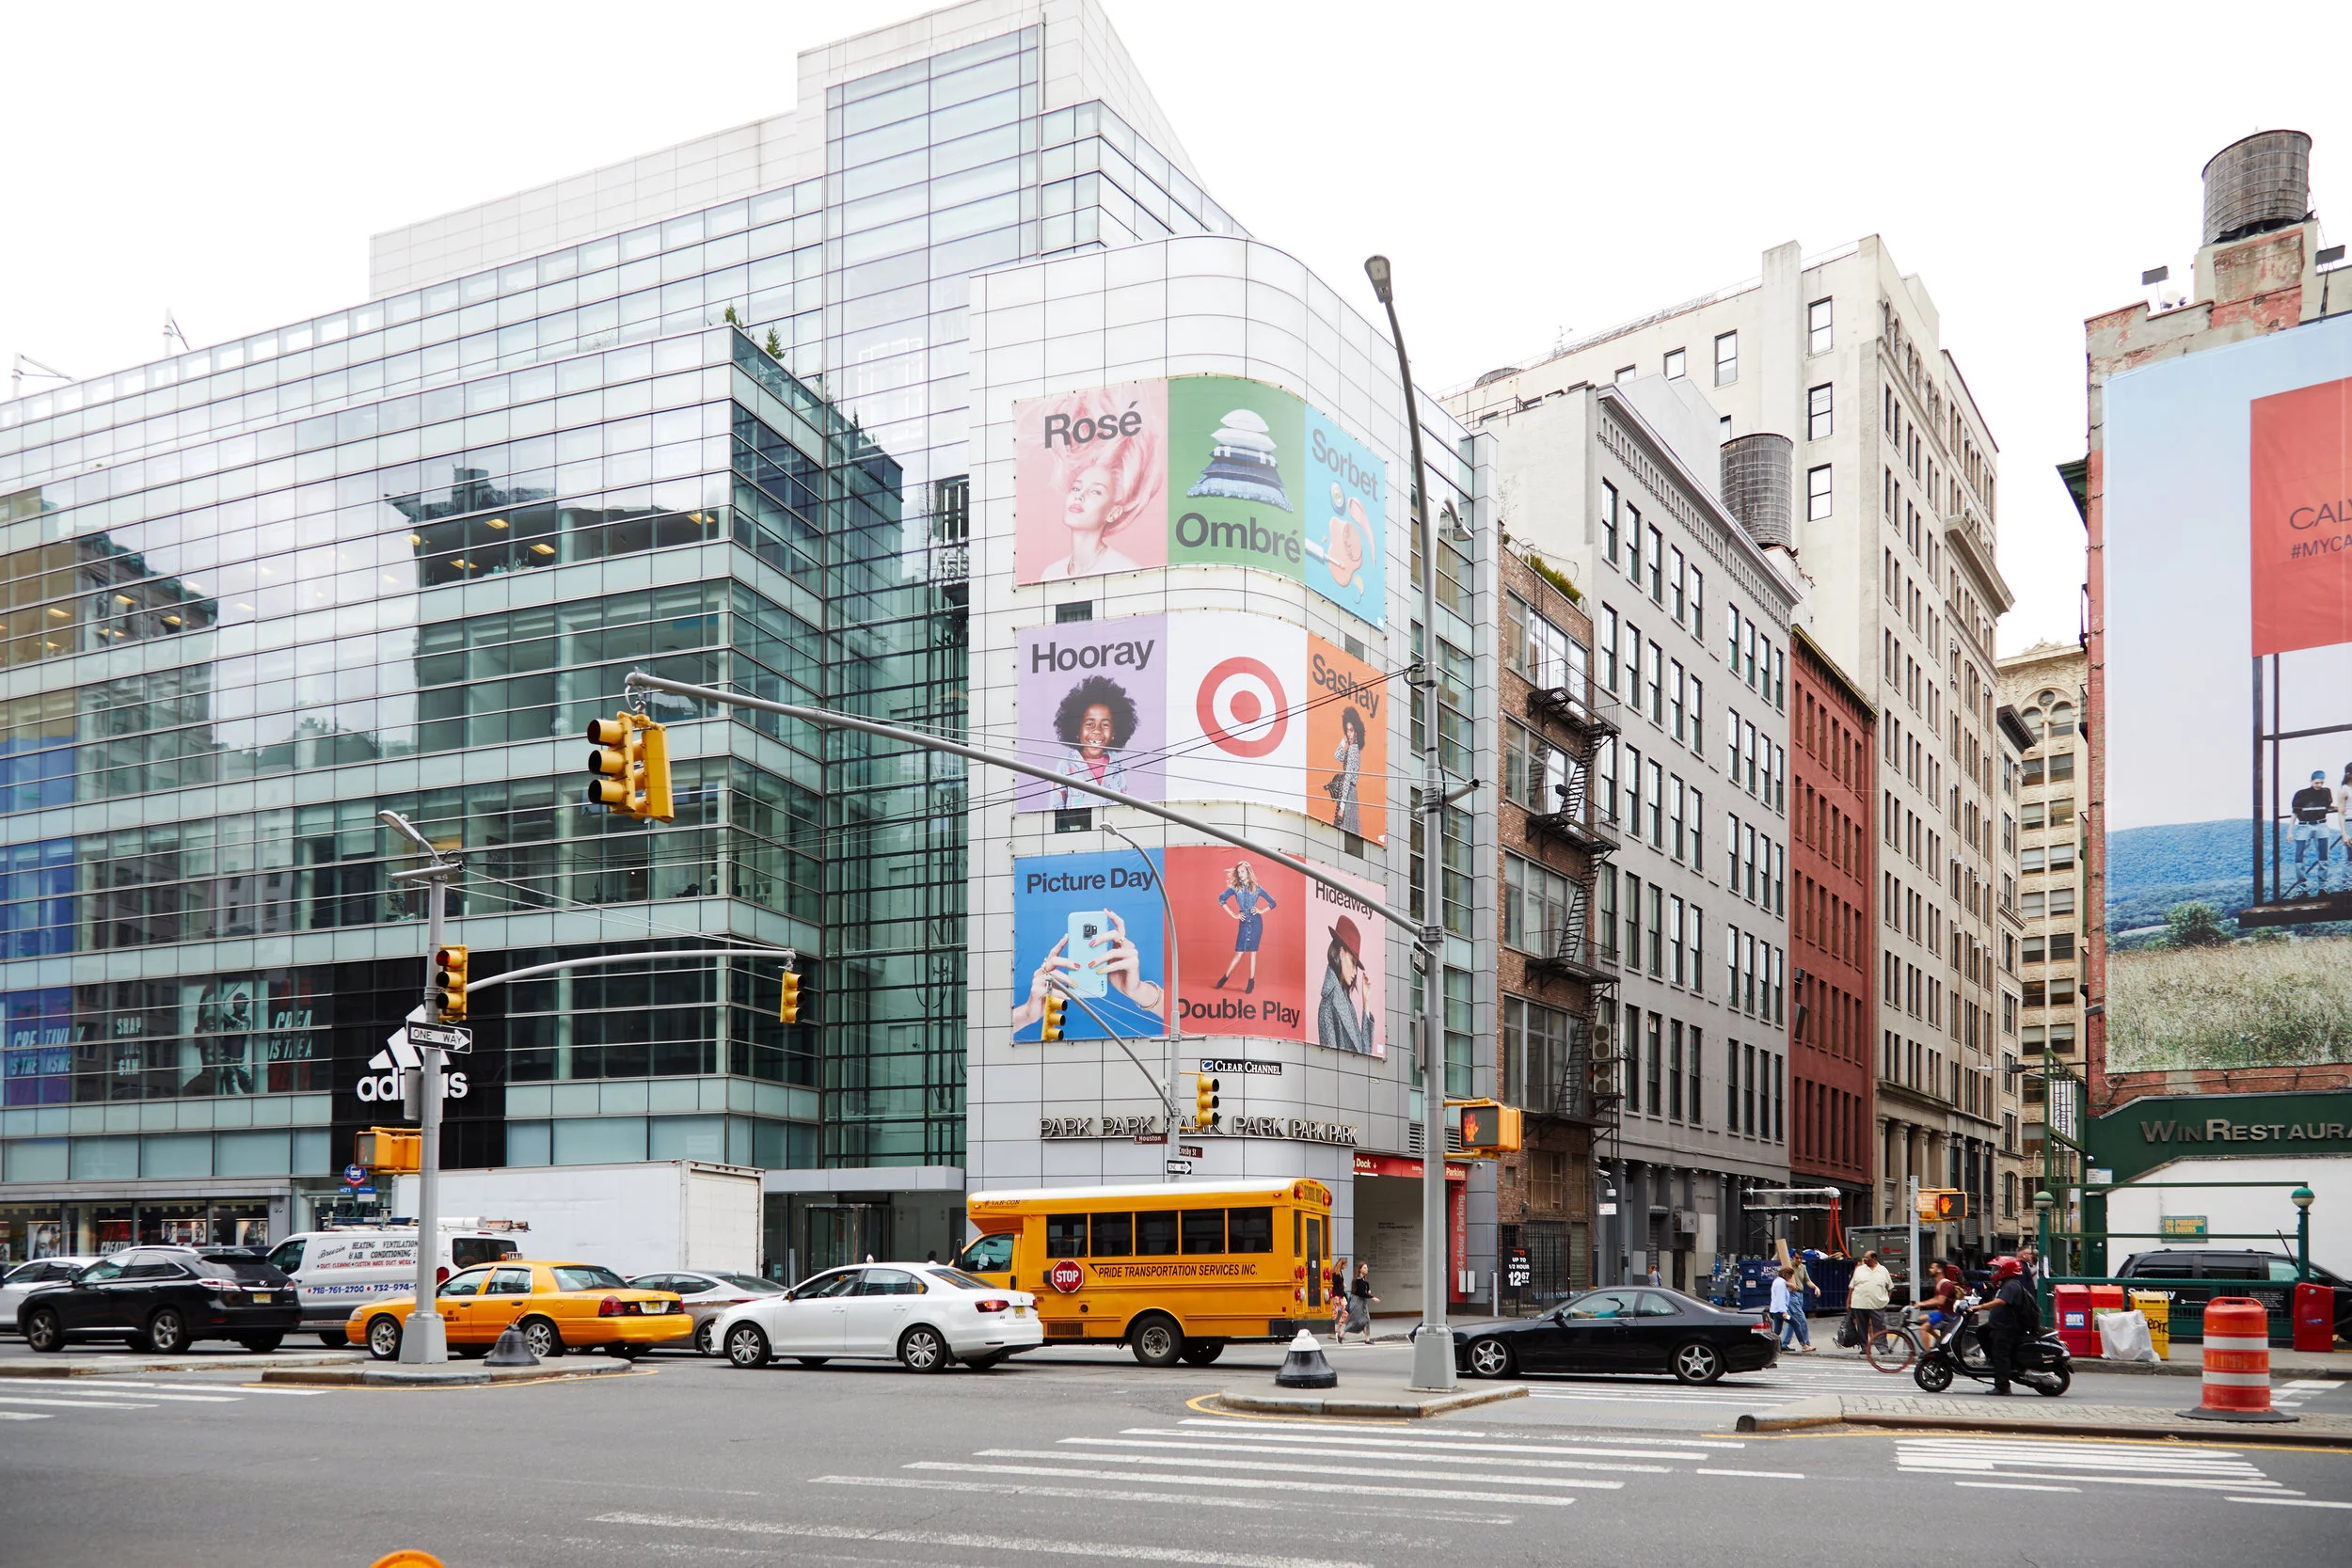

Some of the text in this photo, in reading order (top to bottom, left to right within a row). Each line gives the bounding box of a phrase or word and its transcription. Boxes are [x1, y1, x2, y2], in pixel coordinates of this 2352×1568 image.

[1044, 402, 1142, 449] Rosé
[1311, 428, 1378, 502] Sorbet
[2290, 499, 2352, 530] CAL
[1176, 512, 1301, 563] Ombré
[1031, 639, 1155, 673] Hooray
[1311, 654, 1379, 719] Sashay
[1026, 867, 1154, 894] Picture Day
[1315, 880, 1374, 920] Hideaway
[1178, 998, 1300, 1028] Double Play
[413, 1029, 463, 1045] ONE WAY
[1215, 1060, 1281, 1074] CLEAR CHANNEL
[357, 1067, 468, 1101] adis
[1040, 1117, 1093, 1136] PARK
[1102, 1116, 1155, 1135] PARK
[1233, 1117, 1284, 1135] PARK
[1290, 1119, 1326, 1140] PARK
[1327, 1124, 1358, 1144] PARK
[1179, 1147, 1191, 1157] Crosby
[1356, 1158, 1371, 1169] Dock
[1445, 1166, 1465, 1178] Parking
[1456, 1195, 1465, 1232] Parking
[352, 1242, 375, 1250] HEATING
[371, 1249, 411, 1259] CONDITIONING
[1057, 1270, 1079, 1283] STOP
[1099, 1263, 1258, 1278] PRIDE TRANSPORTATION SERVICES INC.
[312, 1285, 365, 1293] 718-761-2700
